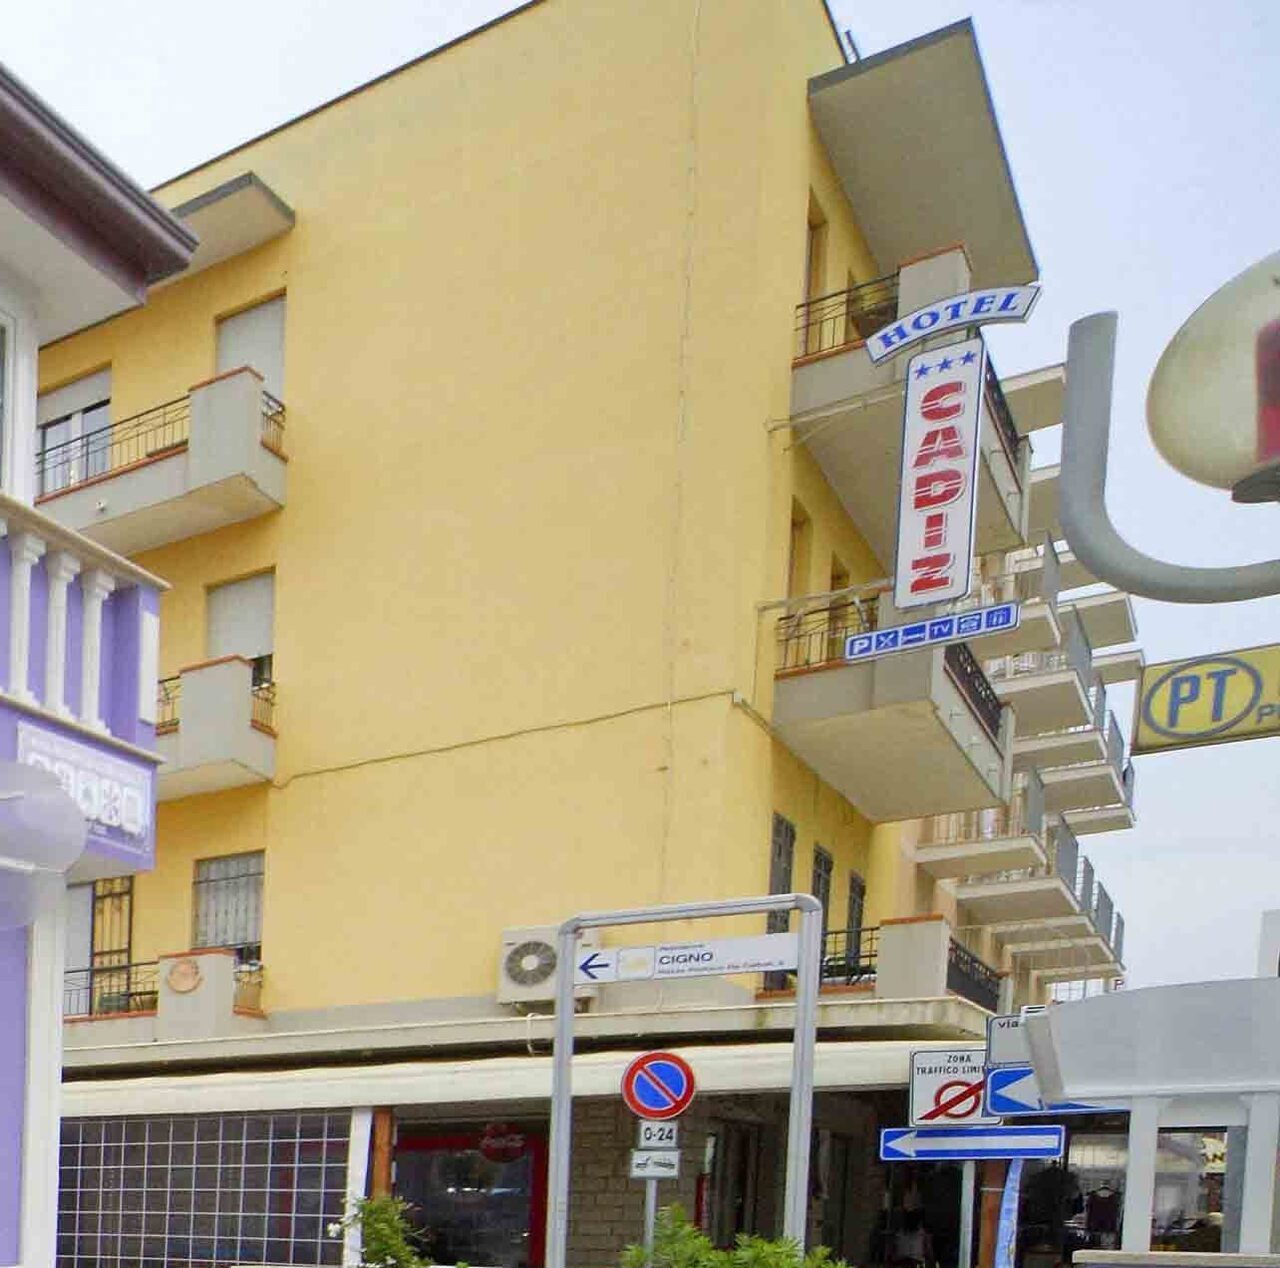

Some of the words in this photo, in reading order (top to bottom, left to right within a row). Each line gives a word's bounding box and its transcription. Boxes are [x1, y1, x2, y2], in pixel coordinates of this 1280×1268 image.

[878, 291, 1019, 349] HOTEL
[910, 380, 967, 594] CADIN
[932, 624, 950, 636] TV
[1167, 669, 1237, 728] PT
[658, 951, 714, 965] CIGNO
